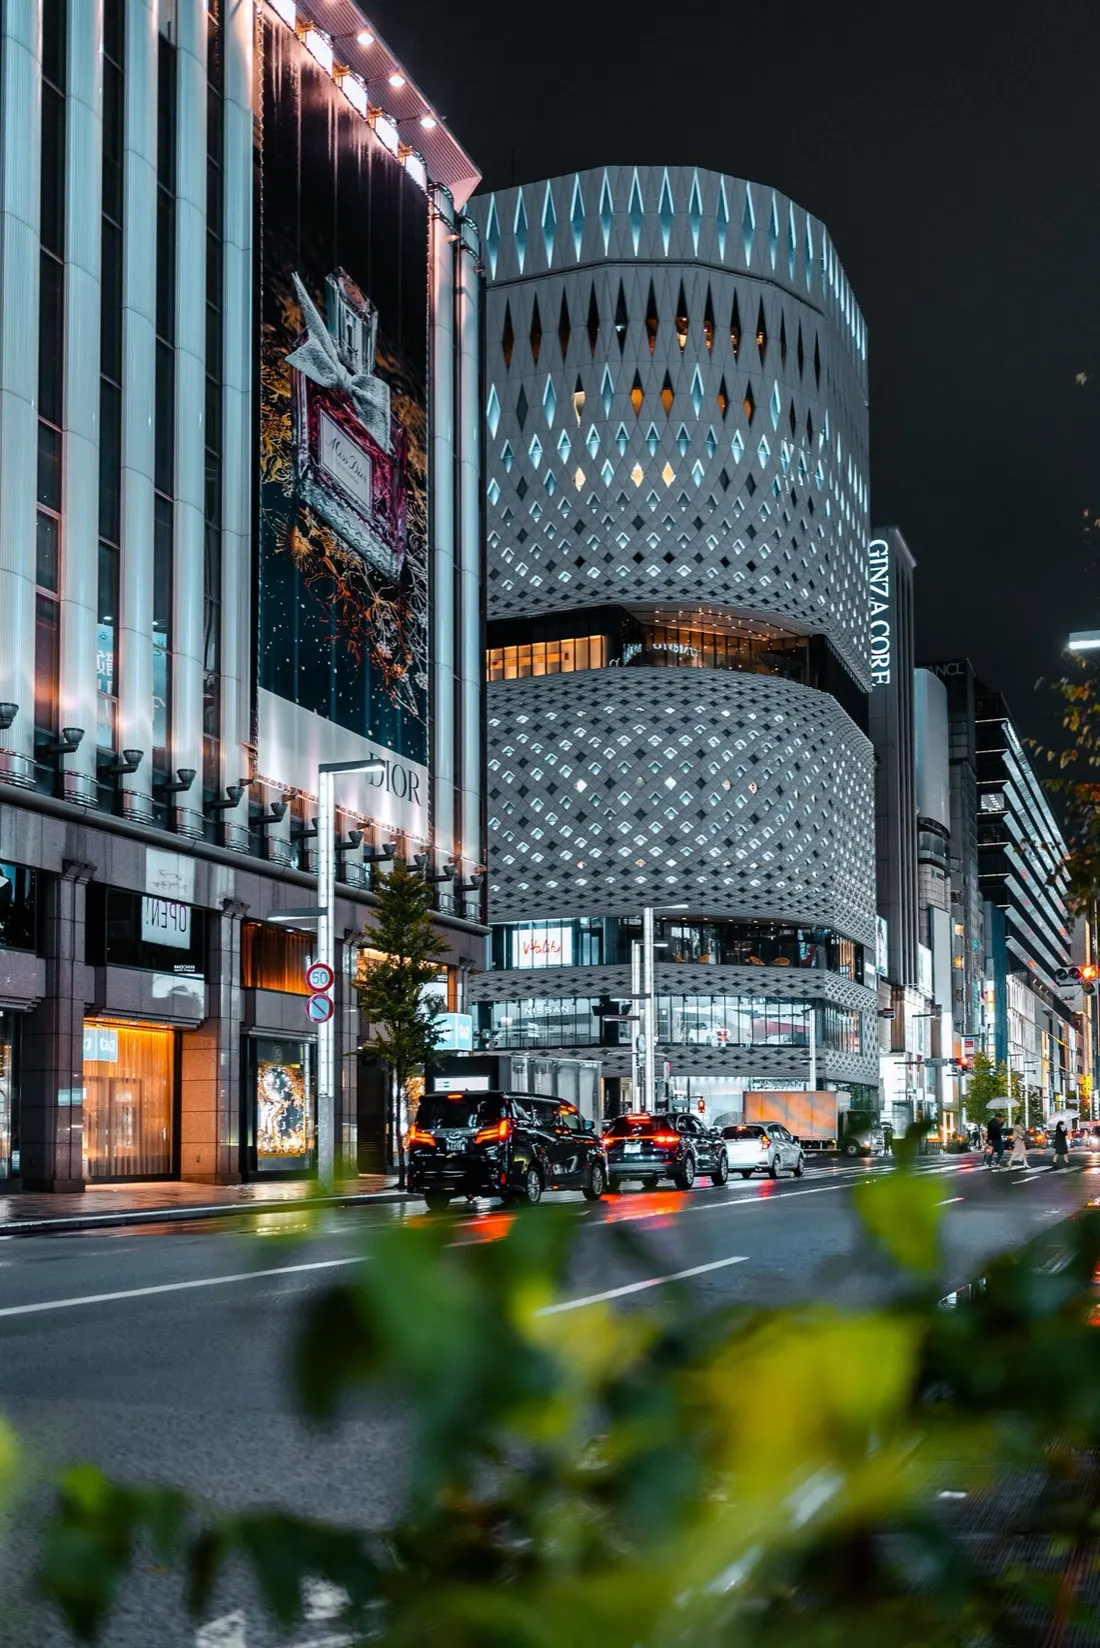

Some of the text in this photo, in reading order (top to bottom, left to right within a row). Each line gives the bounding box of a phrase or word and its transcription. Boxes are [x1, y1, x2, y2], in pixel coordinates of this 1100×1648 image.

[325, 437, 349, 464] Miss
[348, 454, 368, 484] Dior
[869, 539, 891, 687] GINZA CORE
[926, 661, 965, 676] ANCL
[368, 750, 422, 807] DIOR
[312, 971, 328, 985] 50
[524, 1005, 569, 1014] NISSAN
